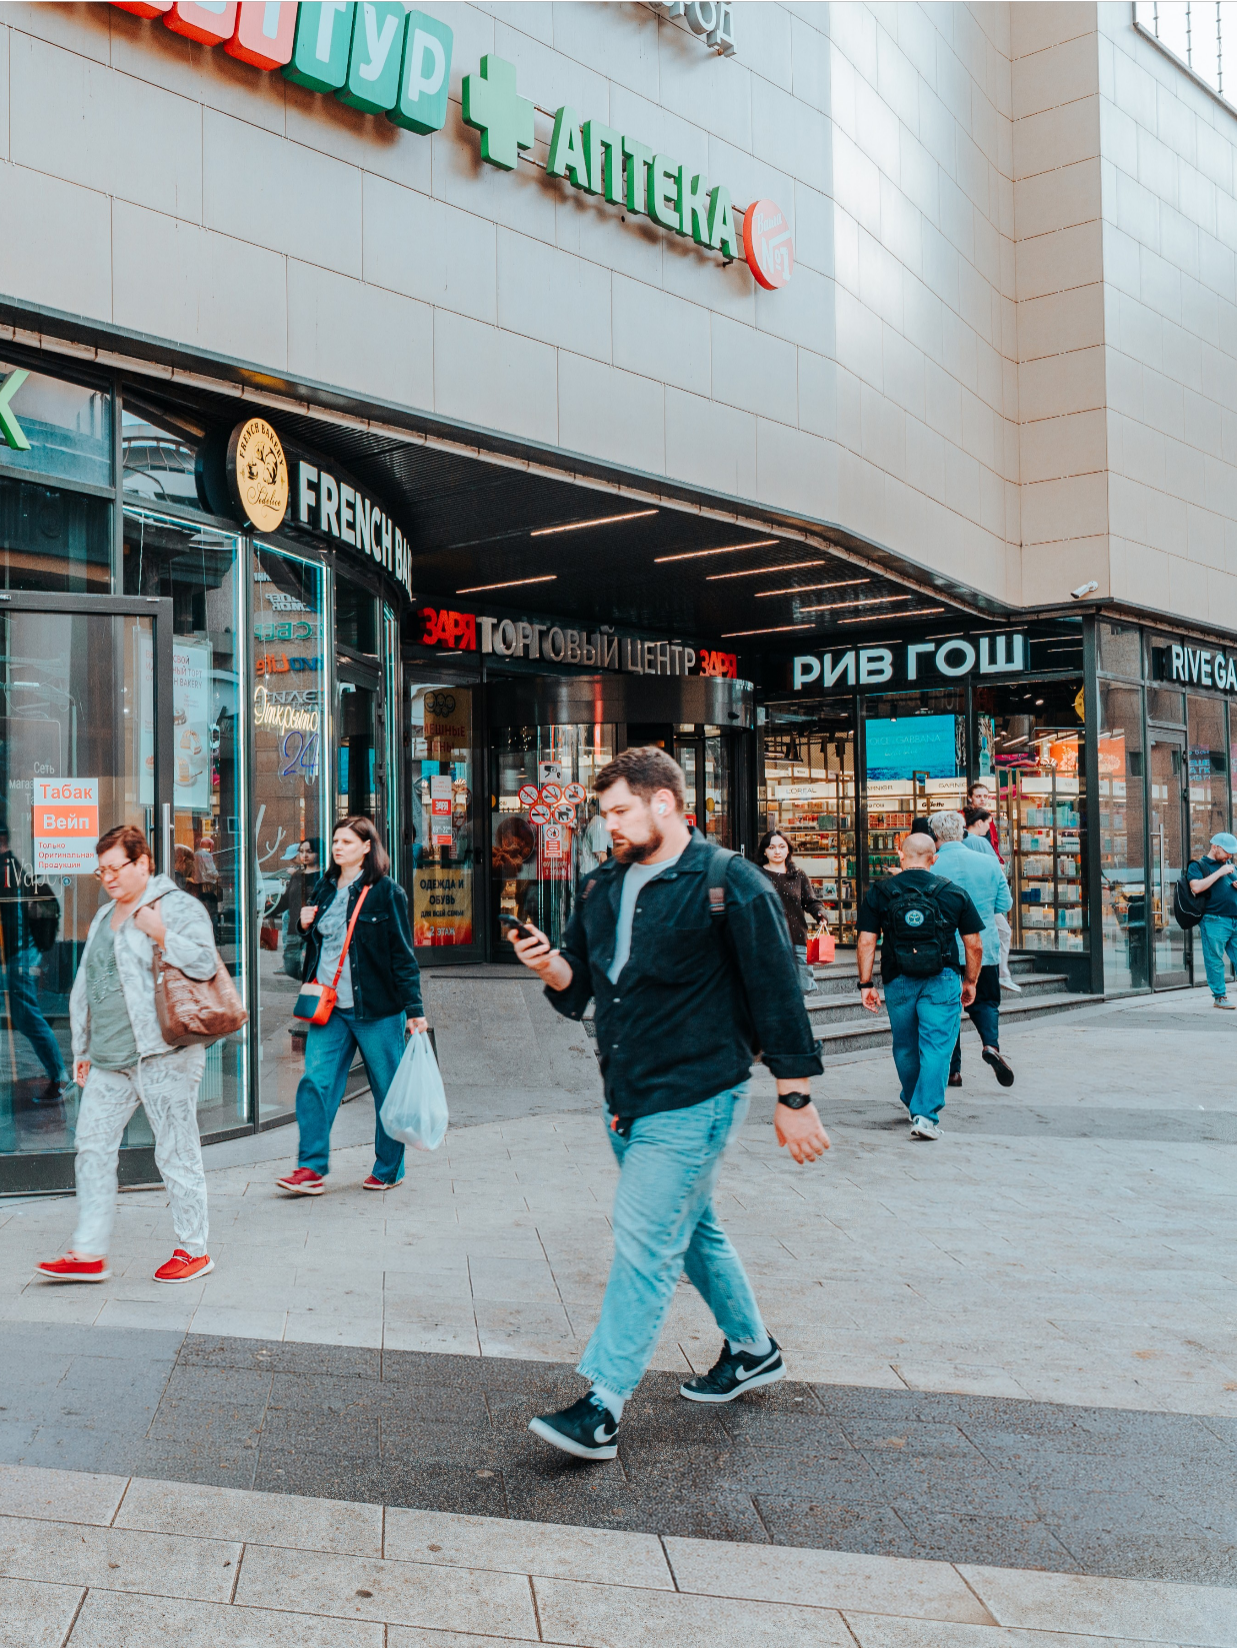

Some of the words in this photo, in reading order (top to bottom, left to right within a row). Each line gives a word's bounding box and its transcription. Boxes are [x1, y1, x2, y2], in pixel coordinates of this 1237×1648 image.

[546, 105, 739, 261] АПТЕКА
[239, 422, 260, 459] FRENCH
[261, 423, 285, 466] BAKERY
[298, 460, 393, 573] FRENCH
[417, 607, 477, 651] ЗАРЯ
[476, 615, 619, 670] ТОРГОВЫЙ
[621, 637, 696, 676] ЦЕНТР
[697, 648, 738, 679] ЗАРЯ
[792, 647, 894, 691] РИВ
[907, 633, 1025, 682] ГОШ
[1171, 643, 1212, 687] RIVE
[253, 685, 318, 737] Открыто
[283, 730, 320, 777] 24
[33, 761, 55, 775] Сеть
[39, 783, 94, 800] Табак
[43, 813, 90, 830] Вейп
[38, 841, 66, 850] Только
[38, 851, 95, 860] Оригинальная
[38, 860, 82, 870] Продукция
[419, 878, 456, 891] ОДЕЖДА
[458, 879, 464, 889] И
[429, 895, 456, 905] ОБУВЬ
[428, 925, 435, 937] 2
[436, 926, 456, 937] ЭТАЖ
